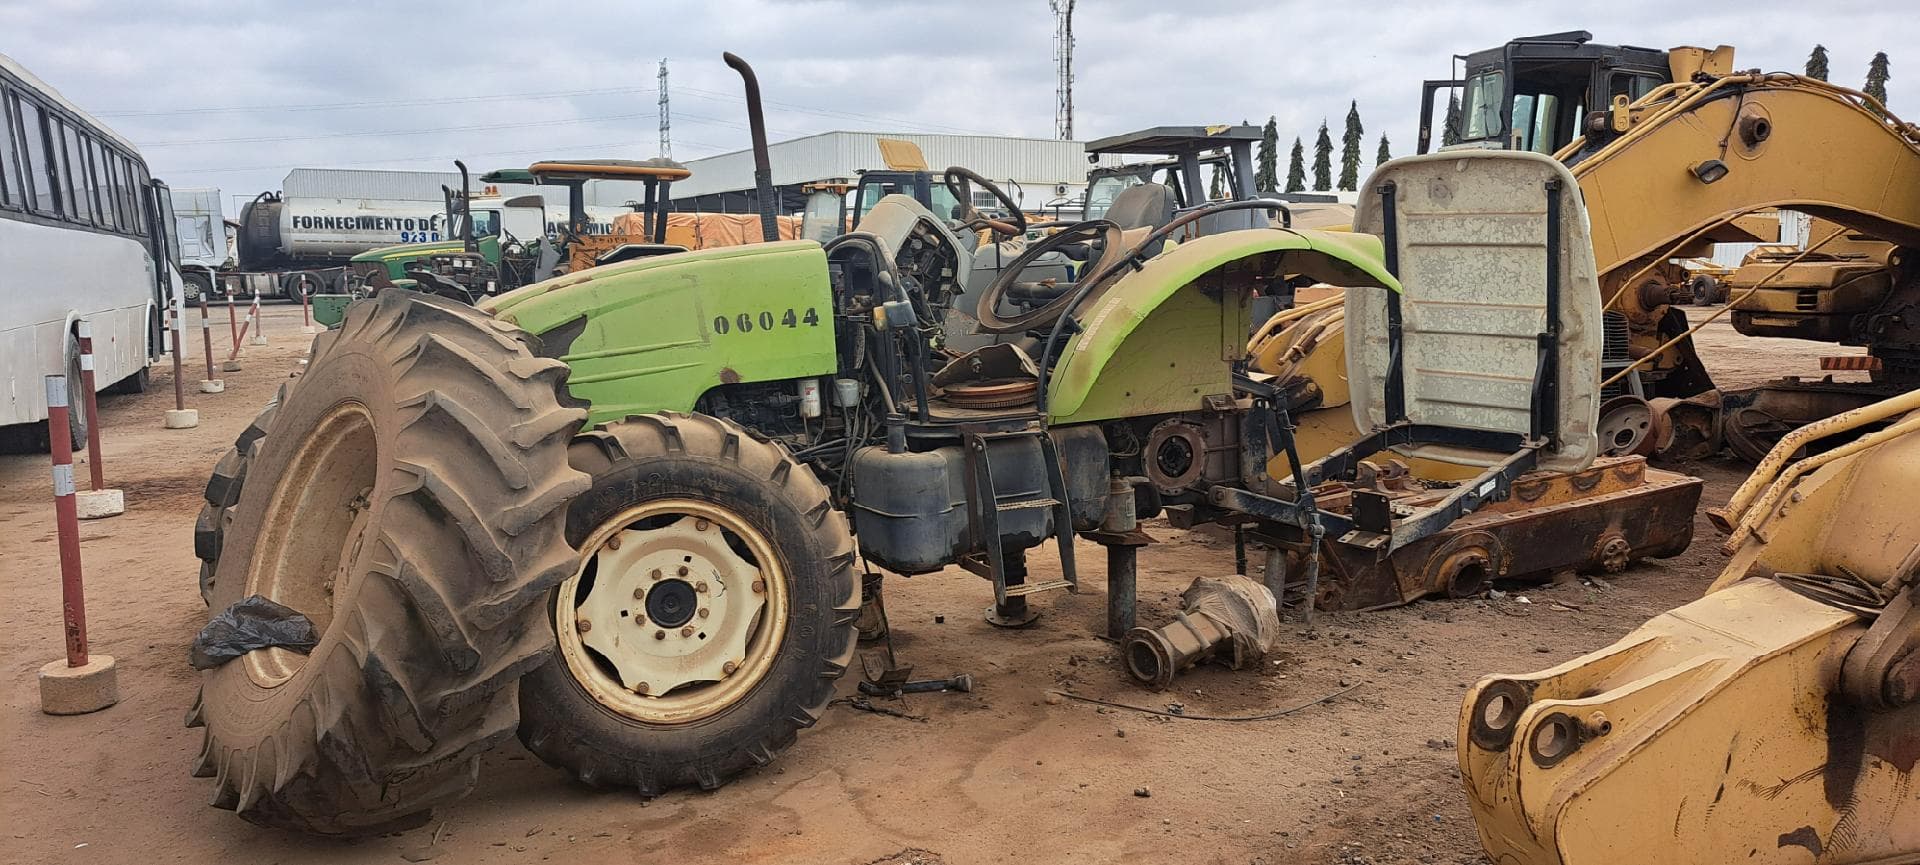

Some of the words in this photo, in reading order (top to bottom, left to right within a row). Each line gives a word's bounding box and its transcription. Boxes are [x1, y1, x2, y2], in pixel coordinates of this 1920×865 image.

[292, 215, 415, 231] FORNECIMENTO
[418, 218, 438, 232] DE
[401, 232, 427, 243] 923
[713, 308, 819, 335] 06044
